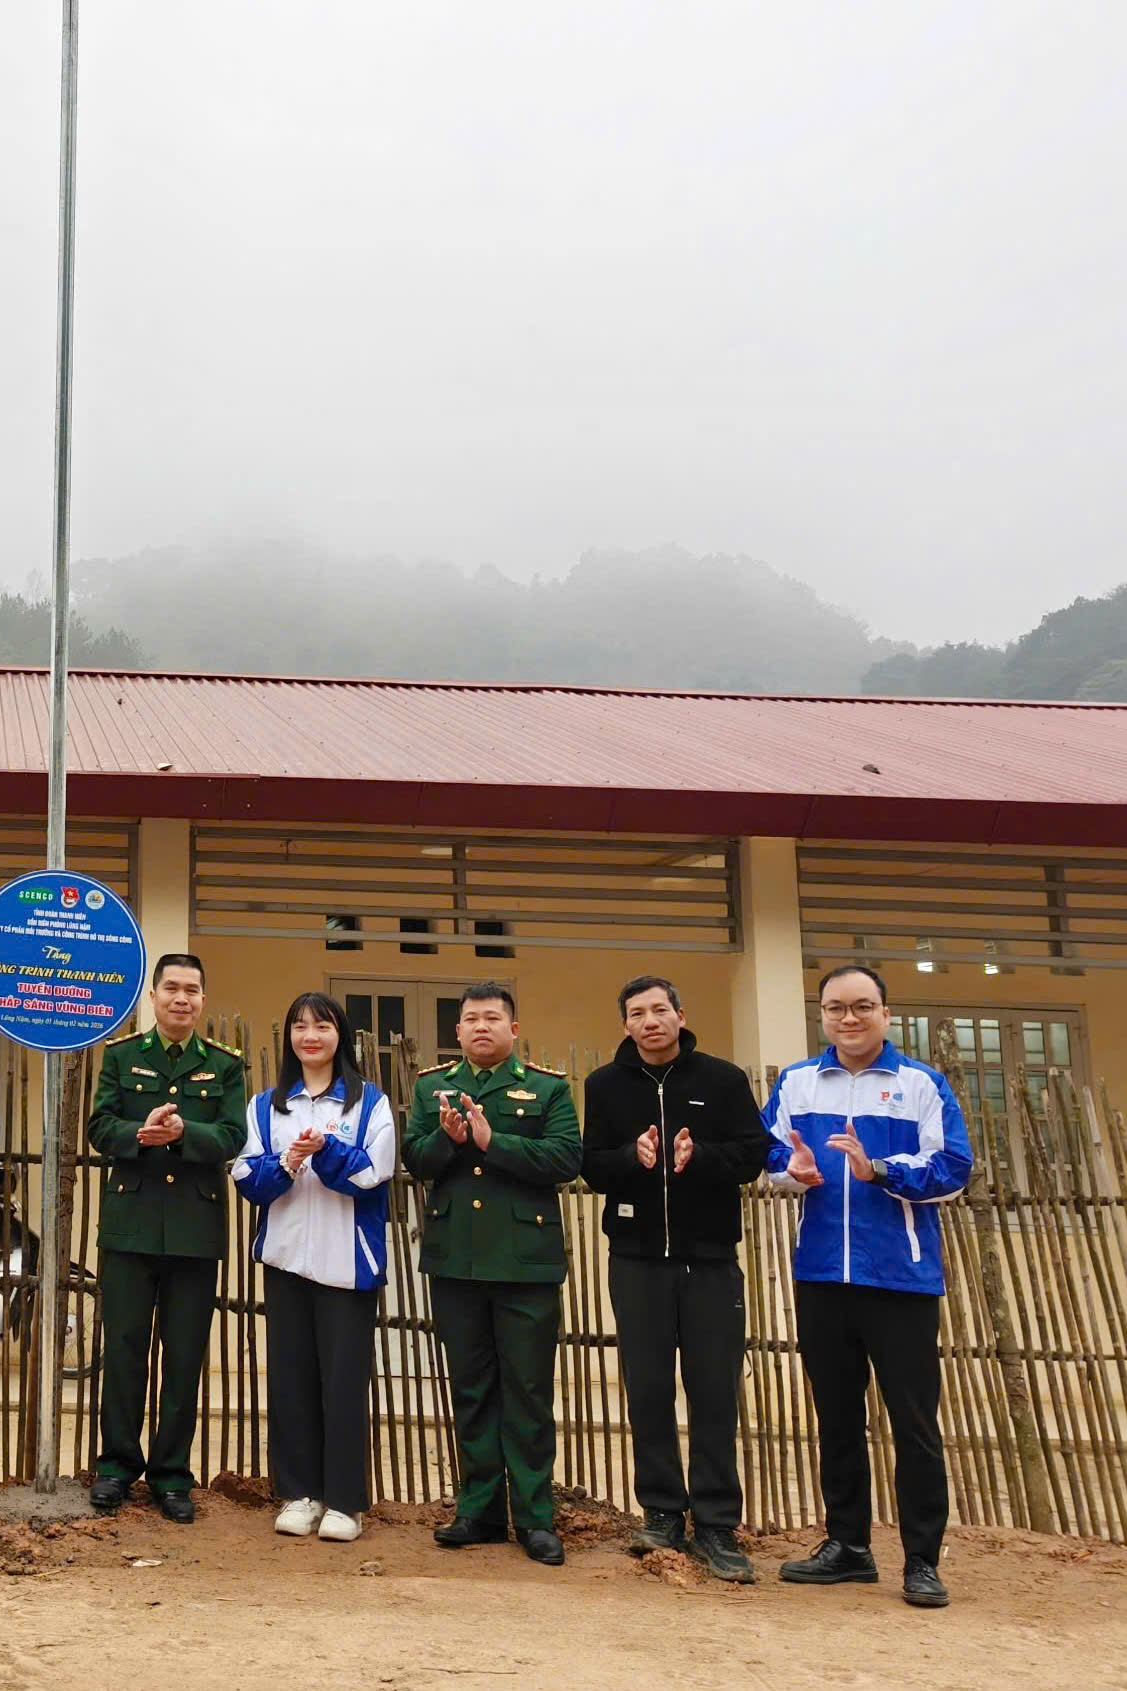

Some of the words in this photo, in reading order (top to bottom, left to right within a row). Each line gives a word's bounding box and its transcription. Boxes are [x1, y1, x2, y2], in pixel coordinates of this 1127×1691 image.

[19, 890, 54, 900] SCENCO
[18, 965, 54, 977] TRÌNH
[57, 968, 96, 980] THANH
[97, 972, 125, 983] NIÊN
[17, 982, 52, 995] TUYẾN
[54, 985, 91, 998] ĐƯỜNG
[23, 998, 54, 1011] SÁNG
[56, 1001, 85, 1014] VÙNG
[87, 1004, 113, 1016] BIÊN
